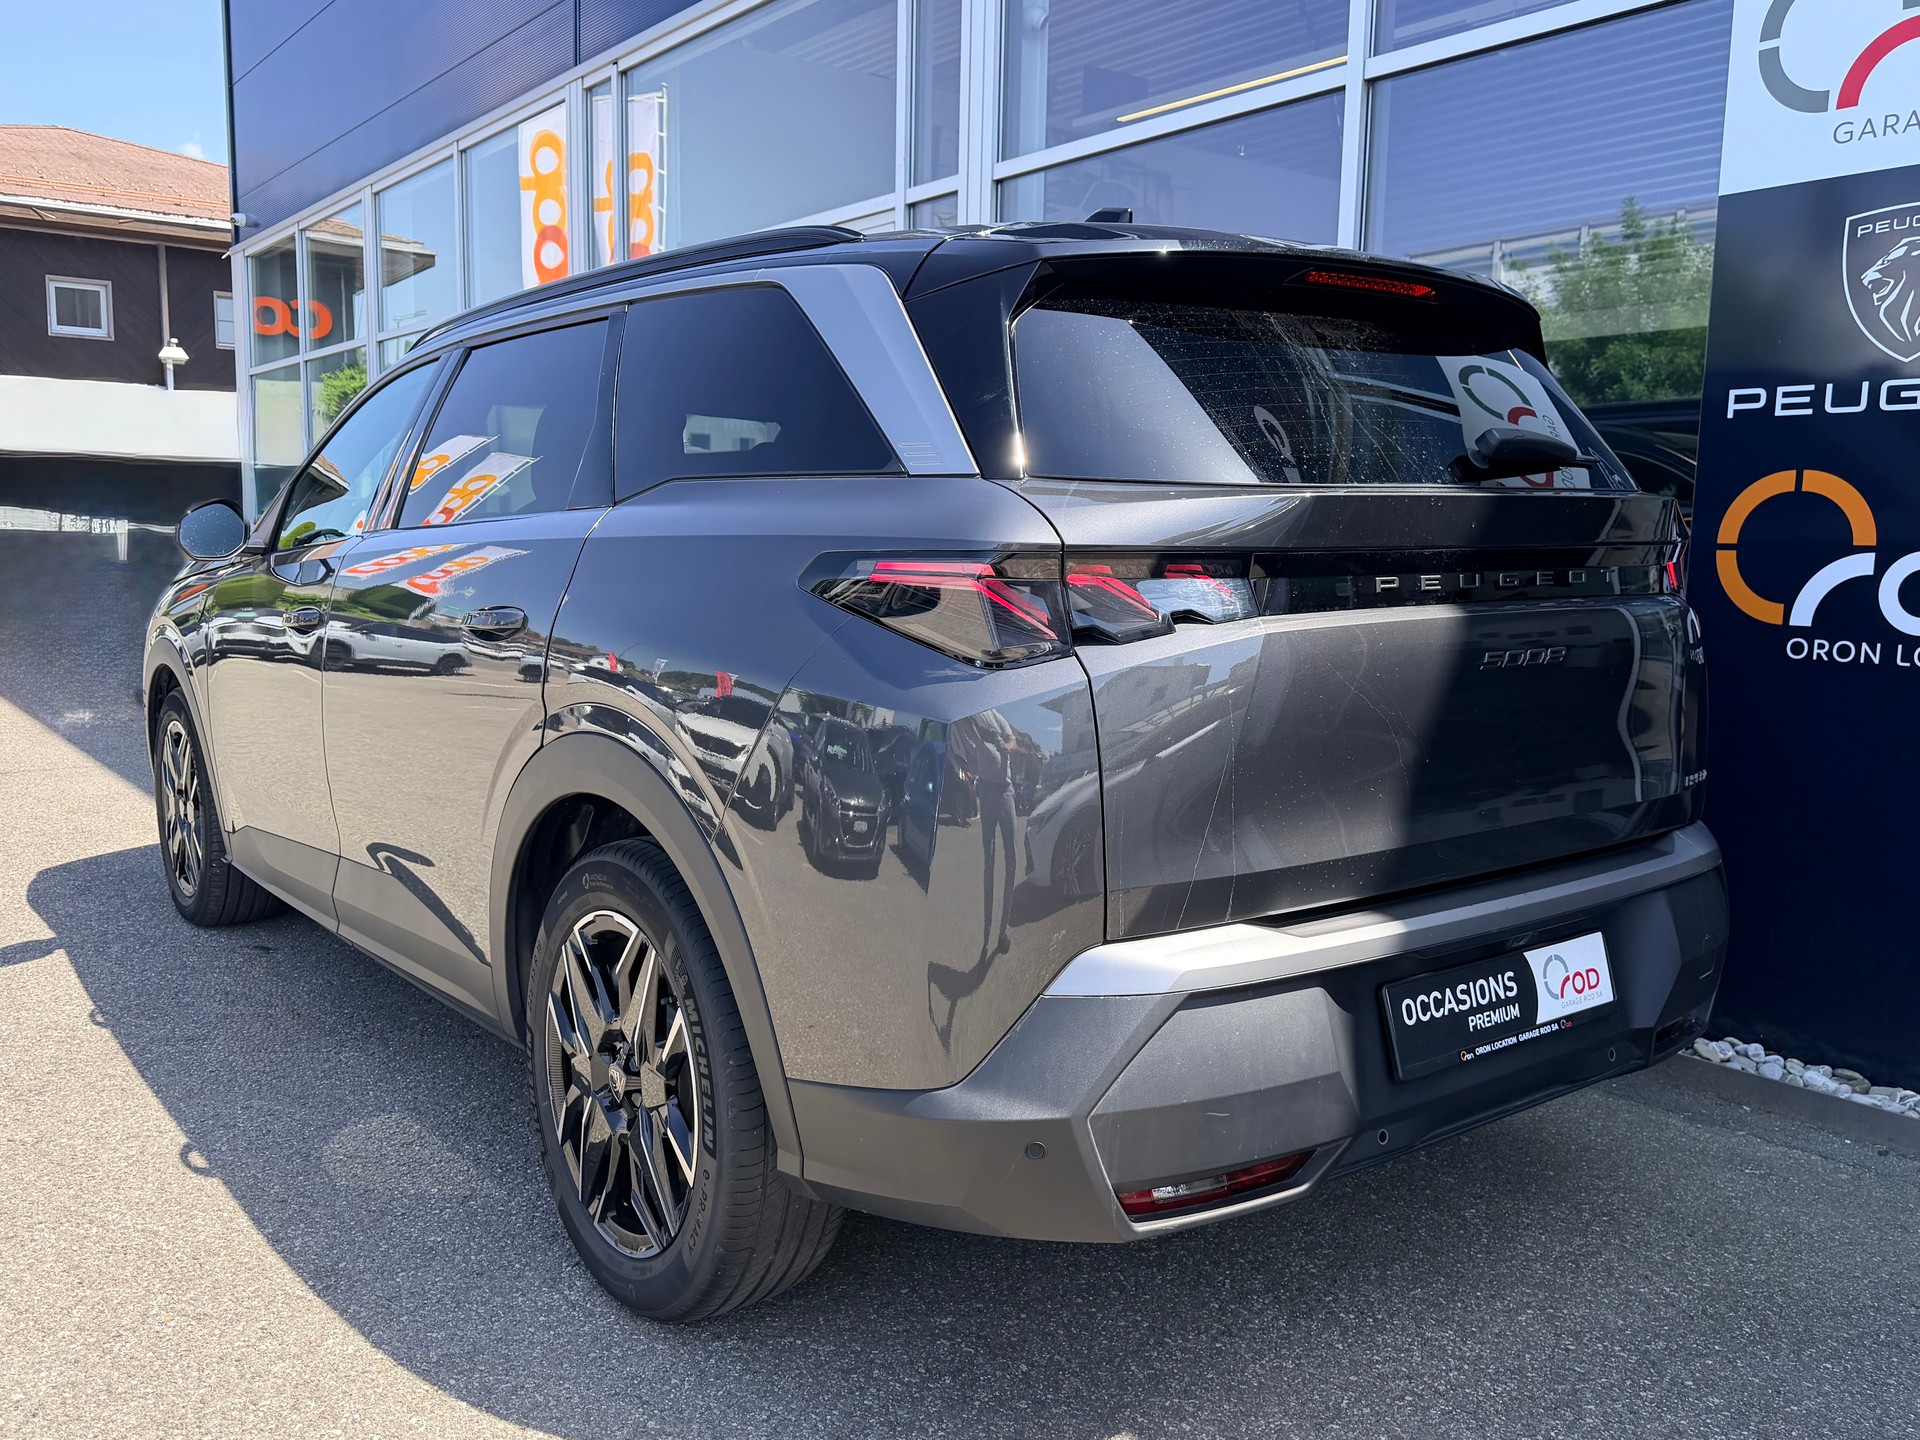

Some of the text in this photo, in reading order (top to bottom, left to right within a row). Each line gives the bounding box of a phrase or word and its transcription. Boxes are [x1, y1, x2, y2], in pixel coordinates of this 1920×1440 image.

[1727, 378, 1920, 419] PEUG
[1375, 569, 1615, 593] PEUGEOT
[1480, 647, 1567, 670] 5008
[1786, 637, 1920, 667] ORON L
[1401, 971, 1518, 1026] OCCASIONS
[1561, 996, 1583, 1009] GARAGE
[1583, 993, 1596, 1002] ROD
[1468, 1003, 1520, 1032] PREMIUM
[1475, 1045, 1491, 1056] ORON
[1491, 1036, 1518, 1051] LOCATION
[1518, 1028, 1540, 1042] GARAGE
[1540, 1025, 1551, 1035] ROD
[1551, 1022, 1559, 1031] SA
[684, 998, 715, 1150] MICHELIN
